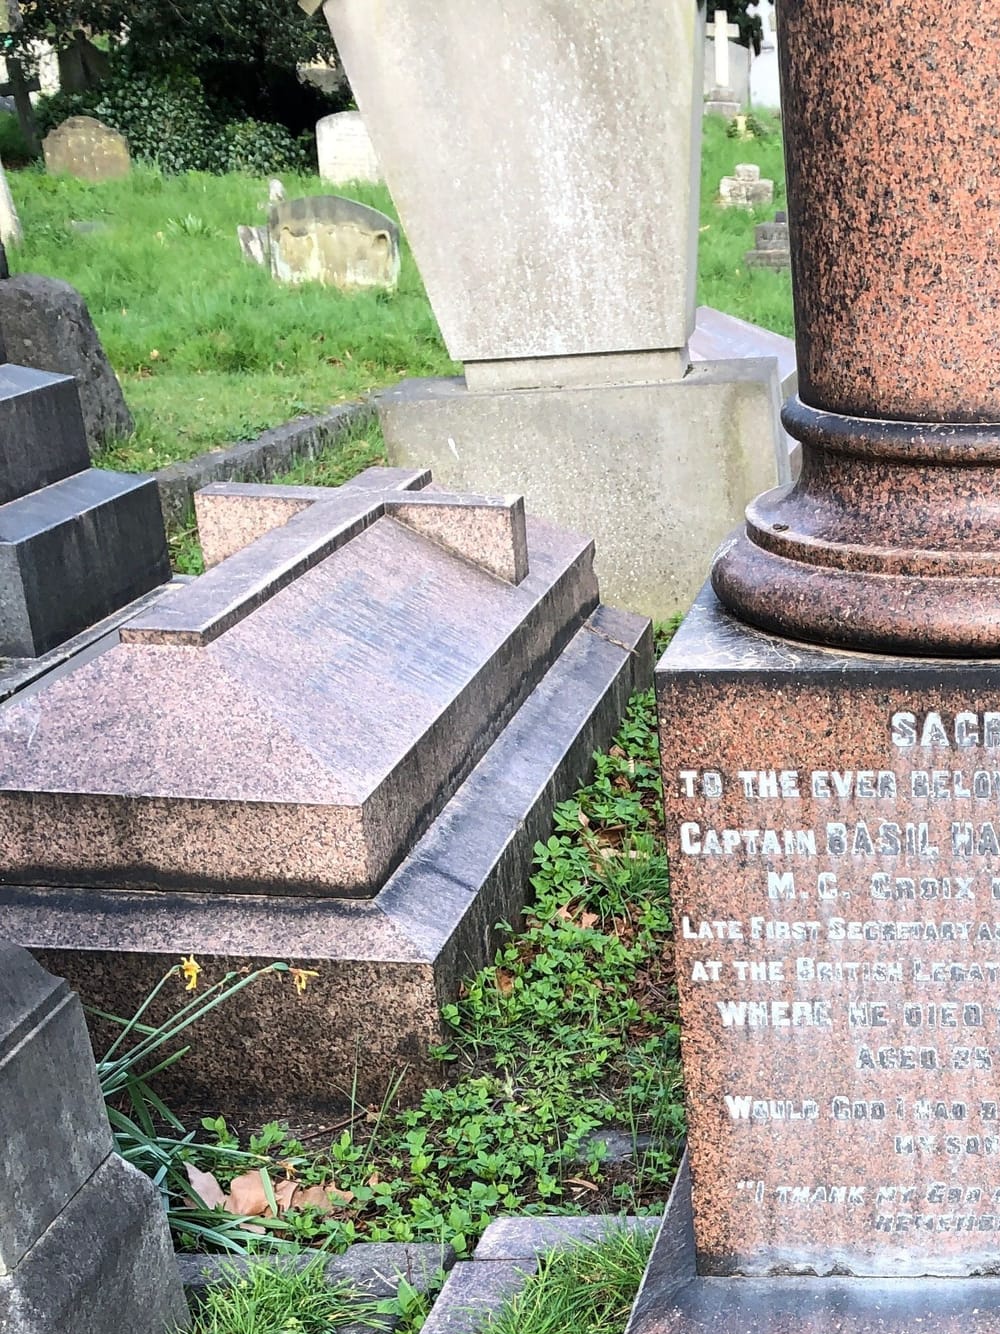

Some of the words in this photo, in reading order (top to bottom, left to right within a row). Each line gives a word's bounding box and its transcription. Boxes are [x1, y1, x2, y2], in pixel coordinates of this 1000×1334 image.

[680, 770, 722, 798] TO
[739, 770, 800, 798] THE
[811, 771, 896, 798] EVER
[680, 822, 816, 856] CAPTAIN
[826, 821, 939, 856] BASIL
[871, 872, 975, 900] CROIX
[682, 916, 743, 939] LATE
[750, 916, 820, 939] FIRST
[829, 917, 971, 940] SECRETARY
[691, 961, 722, 981] AT
[733, 961, 784, 981] THE
[796, 957, 903, 982] BRITISH
[717, 1001, 833, 1027] WHERE
[849, 1001, 889, 1028] HE
[904, 1002, 982, 1028] DIED
[855, 1044, 938, 1070] AGED
[724, 1096, 819, 1120] WOULD
[831, 1095, 886, 1120] GOD
[896, 1097, 904, 1119] I
[915, 1100, 966, 1120] HAD
[894, 1136, 942, 1154] MY
[775, 1186, 866, 1204] THANK
[875, 1186, 916, 1204] MY
[925, 1182, 983, 1204] GOD
